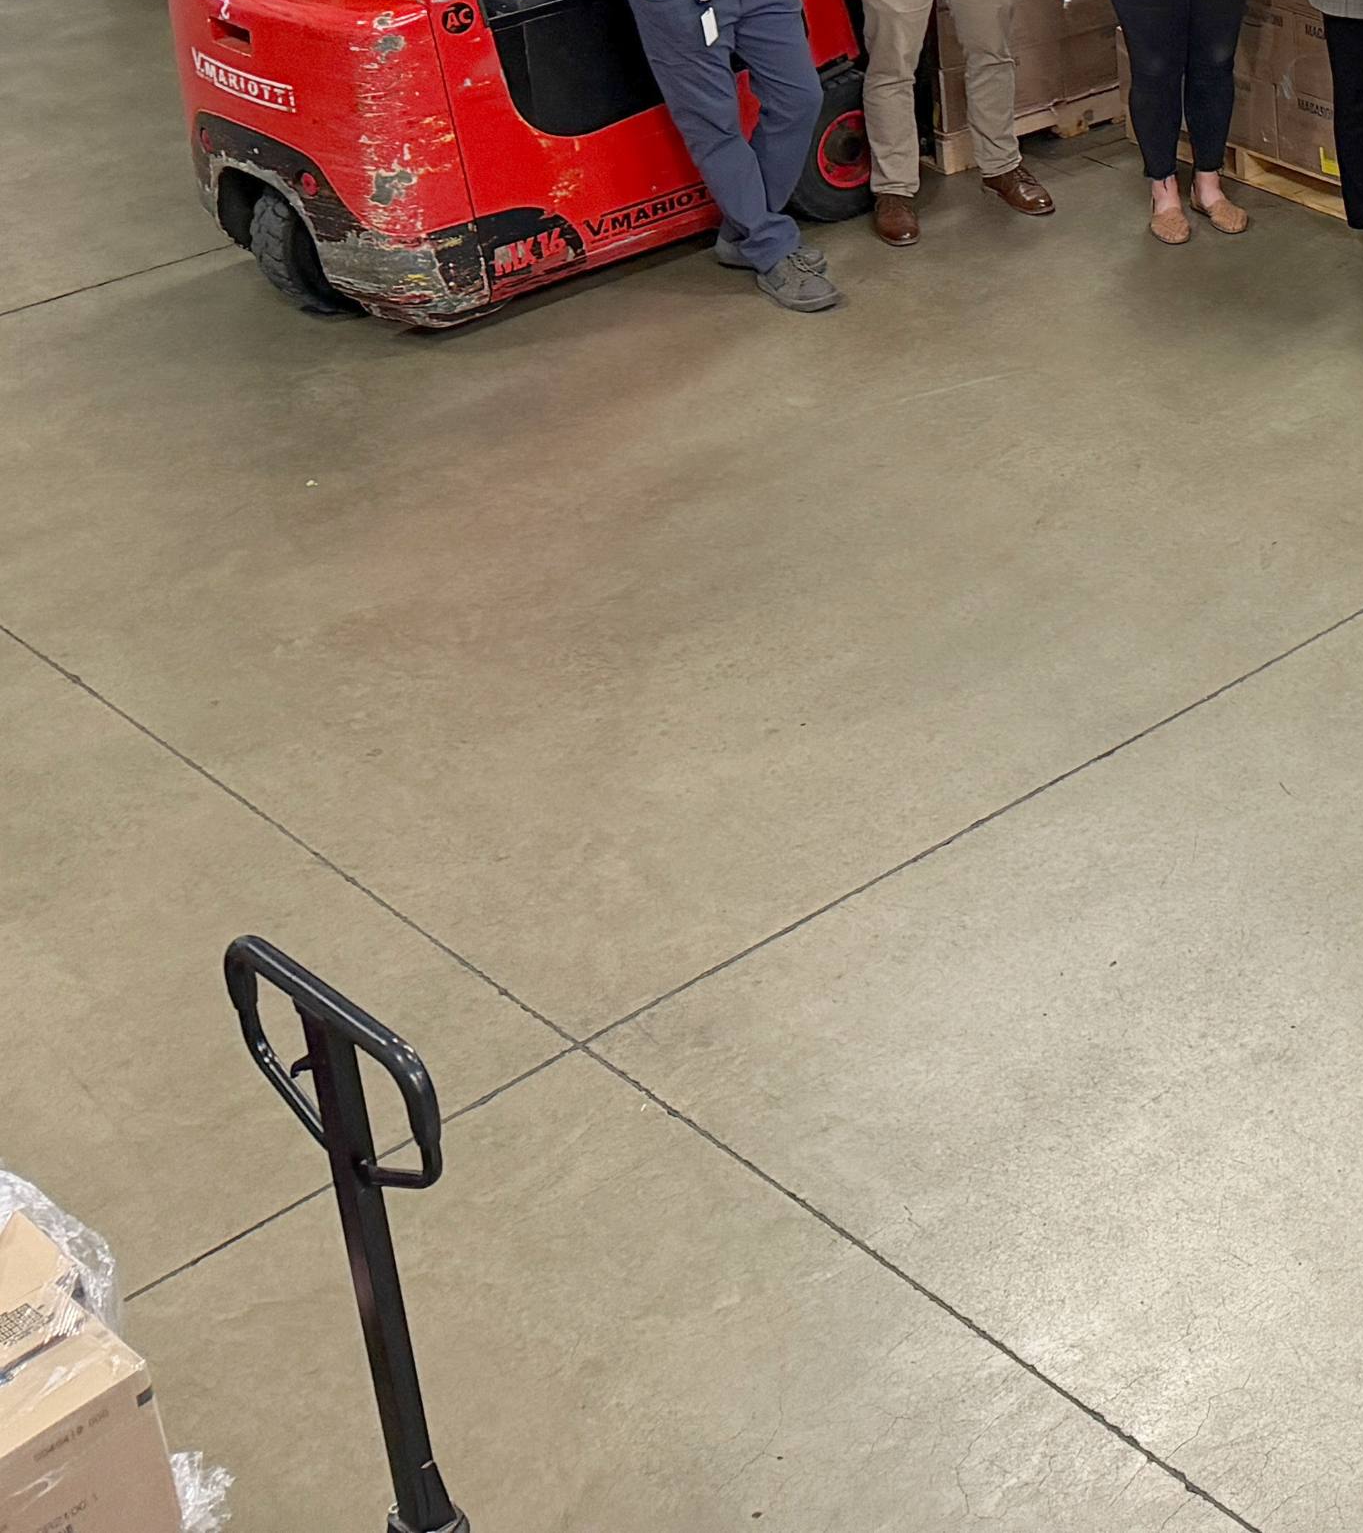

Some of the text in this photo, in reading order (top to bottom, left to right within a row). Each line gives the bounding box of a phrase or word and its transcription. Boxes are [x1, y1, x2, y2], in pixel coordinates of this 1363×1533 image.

[446, 8, 472, 29] AC
[191, 47, 296, 107] V.MARIOTTI
[583, 186, 710, 237] V.MARIOT
